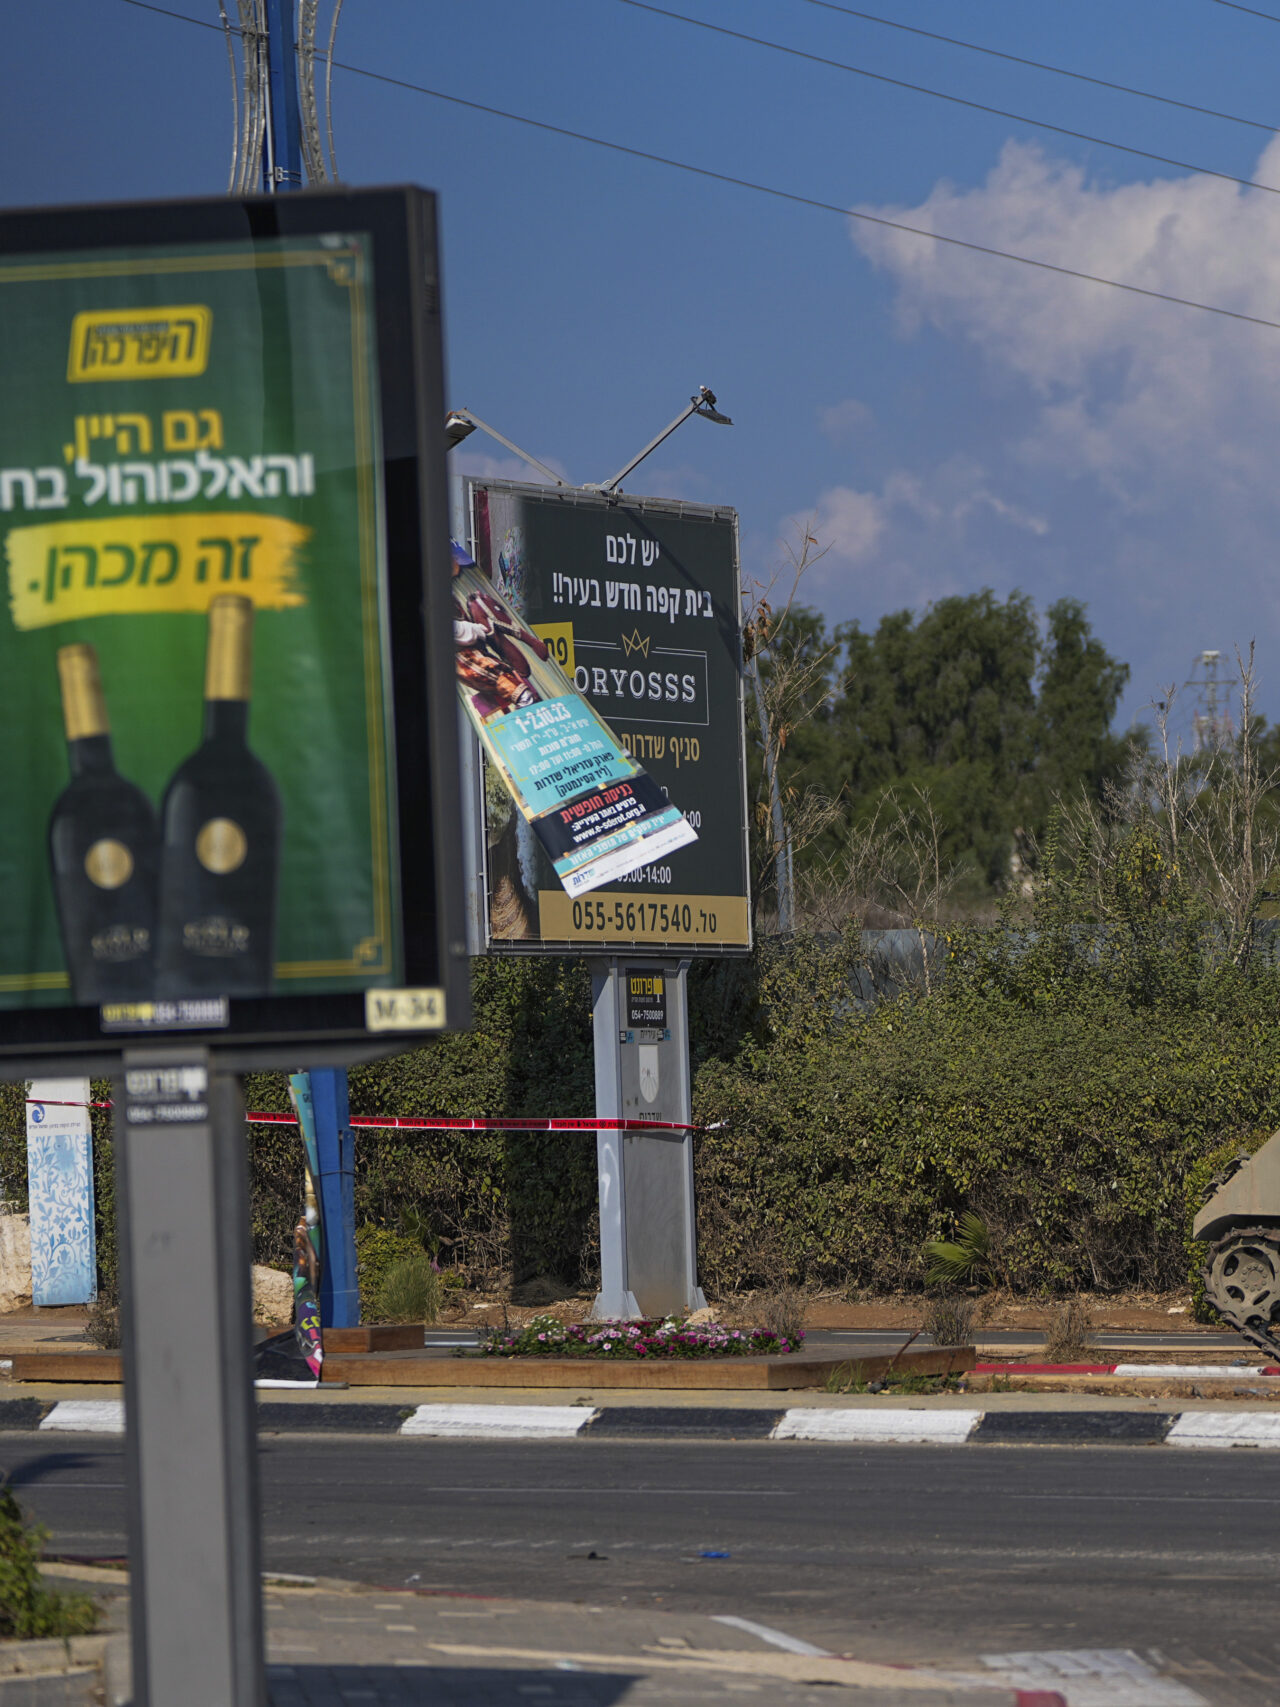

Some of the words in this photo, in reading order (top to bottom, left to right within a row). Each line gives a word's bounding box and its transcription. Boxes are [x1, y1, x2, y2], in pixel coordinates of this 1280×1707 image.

[62, 413, 153, 465] היין,
[162, 409, 223, 452] גם
[75, 451, 315, 506] והאלכוהול
[194, 535, 262, 585] זה
[605, 533, 637, 565] לכם
[641, 539, 660, 567] יש
[27, 541, 182, 604] מכהן.
[552, 572, 601, 607] בעיר!!
[605, 580, 642, 611] חדש
[646, 585, 681, 624] קפה
[685, 589, 713, 618] בית
[593, 752, 614, 765] פארק
[669, 736, 700, 768] סניף
[534, 771, 564, 791] שדרות
[602, 783, 634, 802] כניסה
[560, 797, 605, 824] חופשית
[572, 804, 647, 843] www.e-sderot.org.il
[572, 900, 692, 933] 055-5617540
